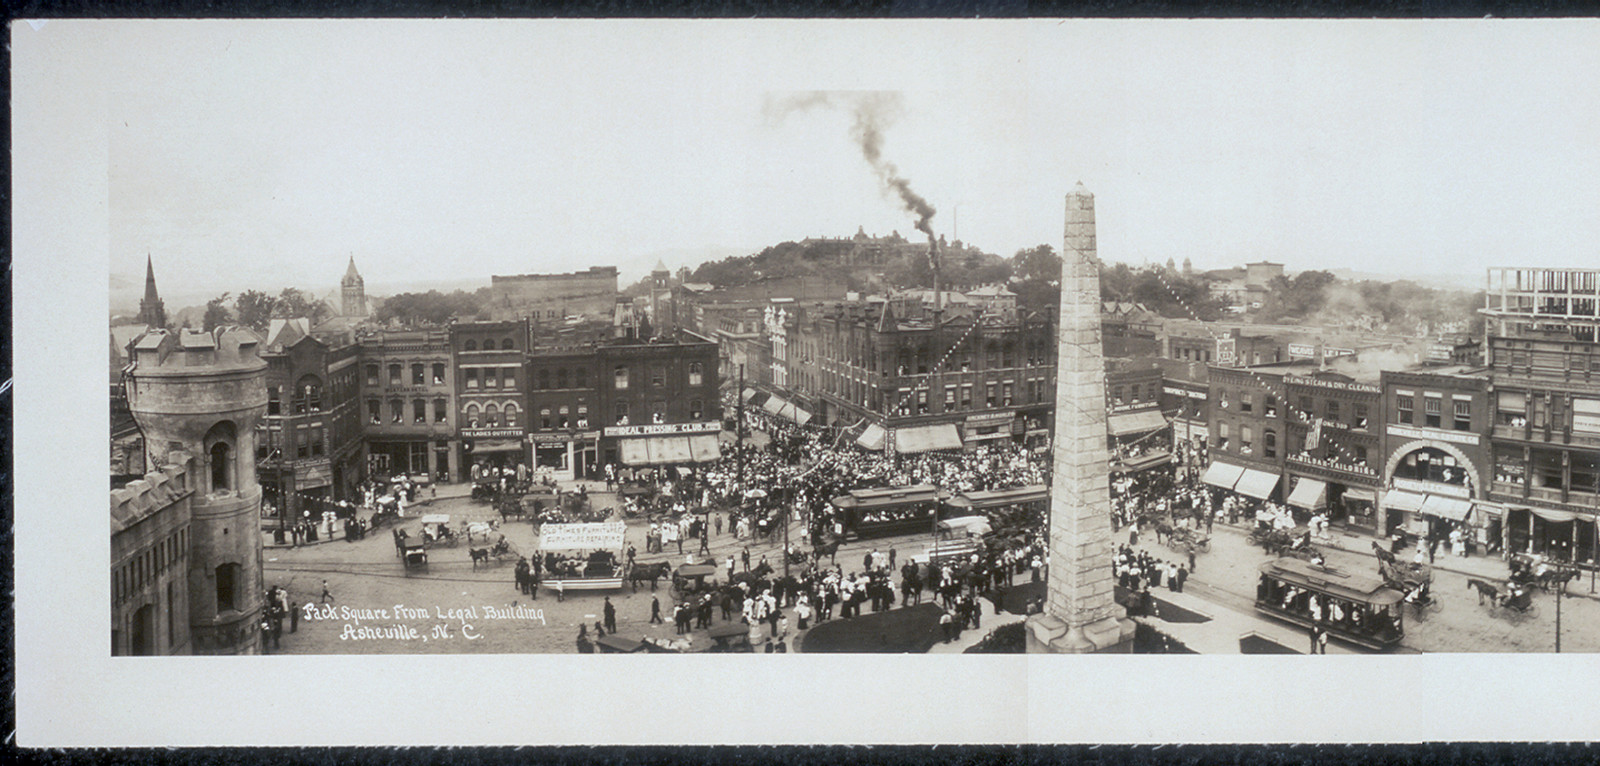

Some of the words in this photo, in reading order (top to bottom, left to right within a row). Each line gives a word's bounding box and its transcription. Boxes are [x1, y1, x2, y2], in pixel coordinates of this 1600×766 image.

[1283, 376, 1304, 385] DYEING
[1305, 378, 1326, 388] STEAM
[1347, 383, 1382, 393] CLEANING
[619, 425, 641, 435] IDEAL
[643, 424, 677, 434] PRESSING
